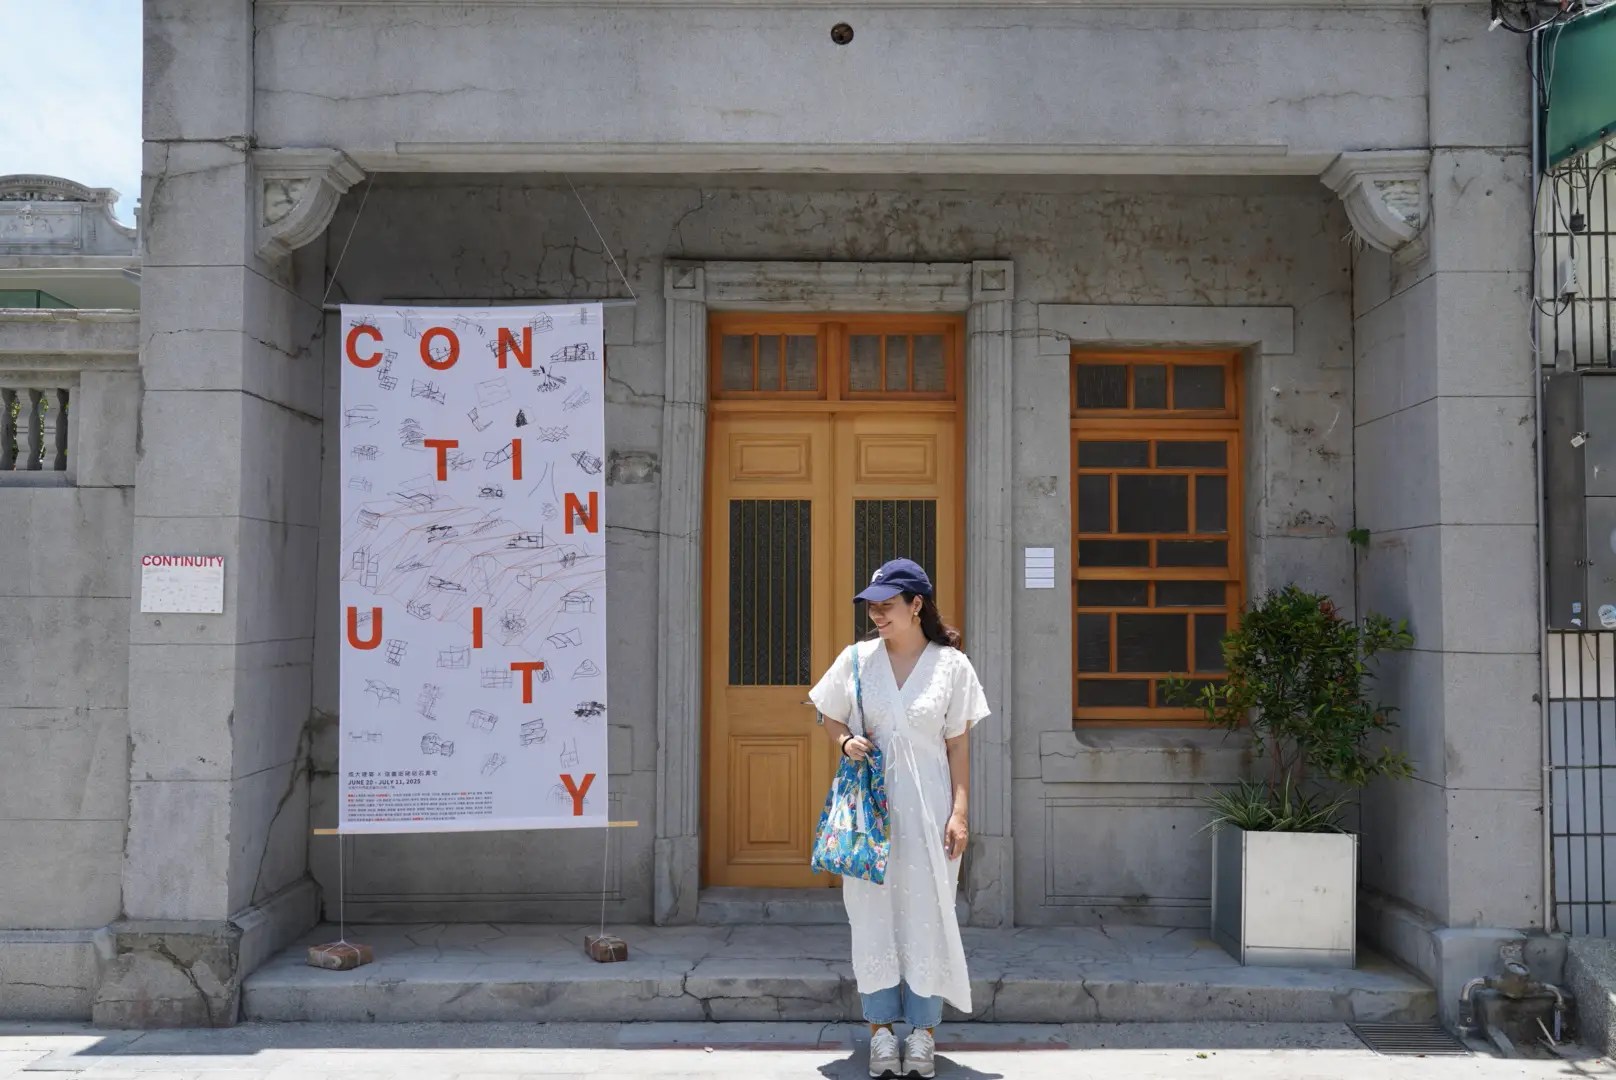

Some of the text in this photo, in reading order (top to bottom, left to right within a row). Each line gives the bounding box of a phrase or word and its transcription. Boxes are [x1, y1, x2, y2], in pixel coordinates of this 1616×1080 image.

[346, 325, 532, 370] C O N
[424, 439, 522, 481] T I
[564, 492, 598, 534] N
[142, 555, 224, 567] CONTINUITY
[347, 607, 483, 650] U I
[510, 662, 544, 703] T
[560, 774, 596, 816] Y
